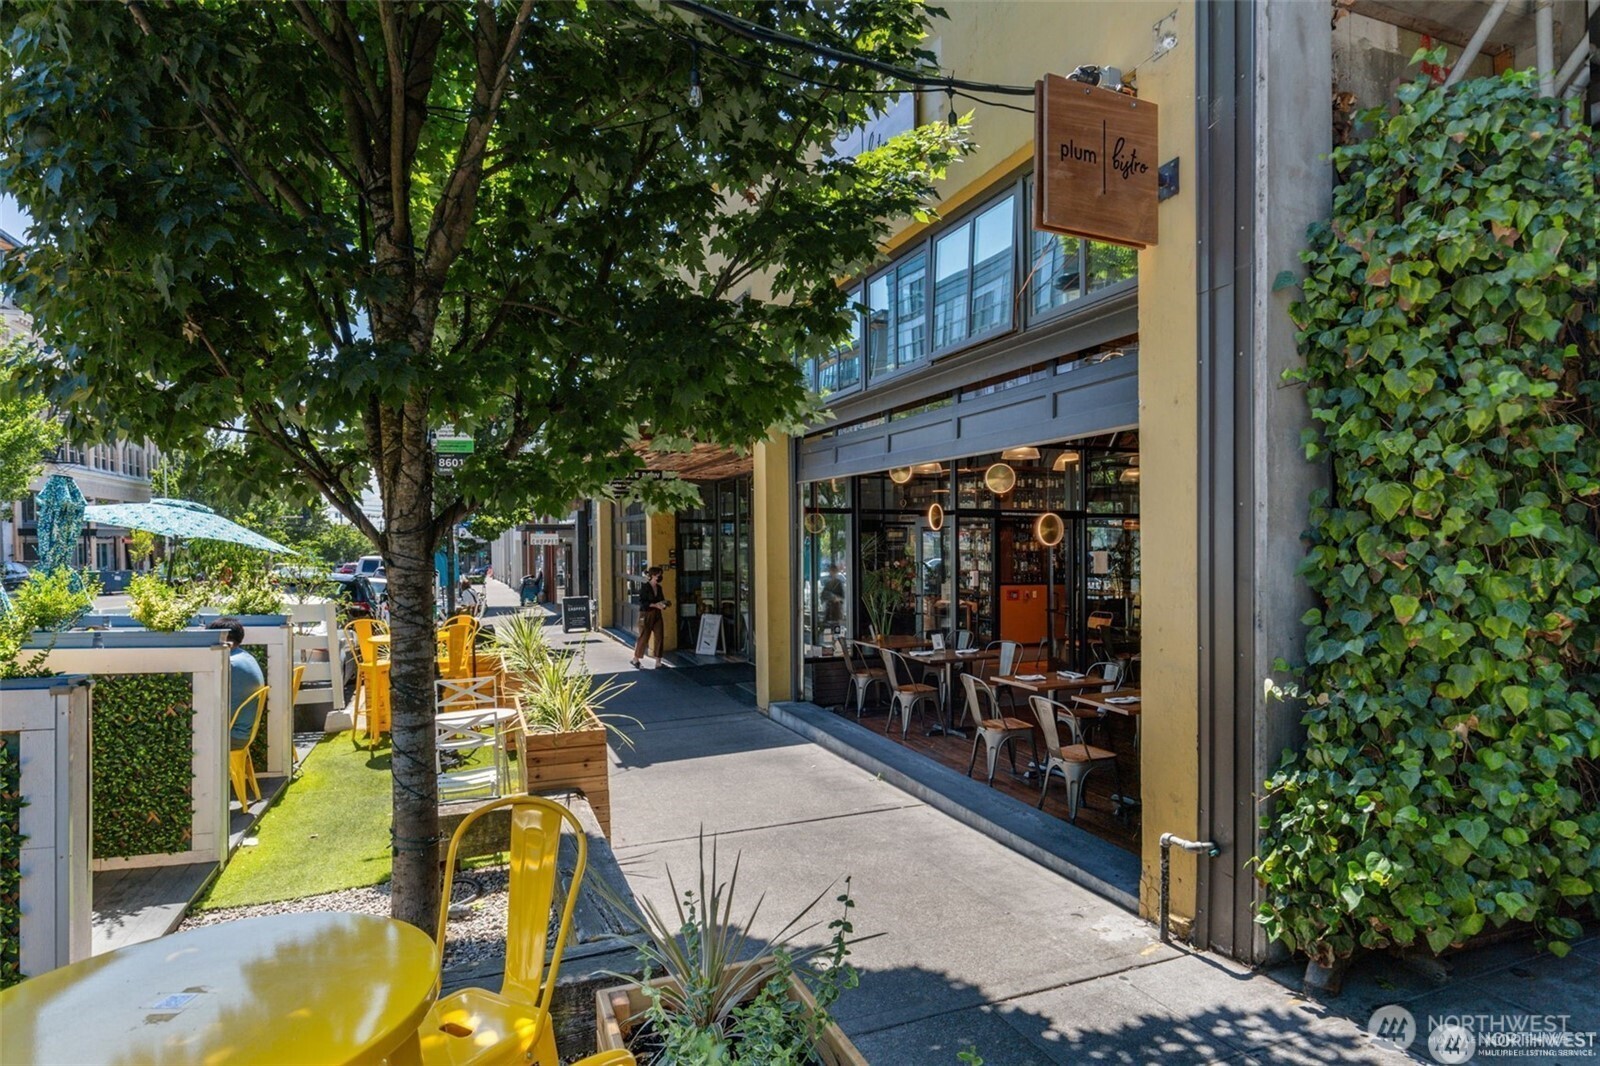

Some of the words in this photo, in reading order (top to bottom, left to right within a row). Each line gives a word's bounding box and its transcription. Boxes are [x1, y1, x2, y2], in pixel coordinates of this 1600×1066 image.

[1060, 139, 1097, 164] plum
[1112, 137, 1149, 180] bistro
[438, 458, 464, 467] 8601
